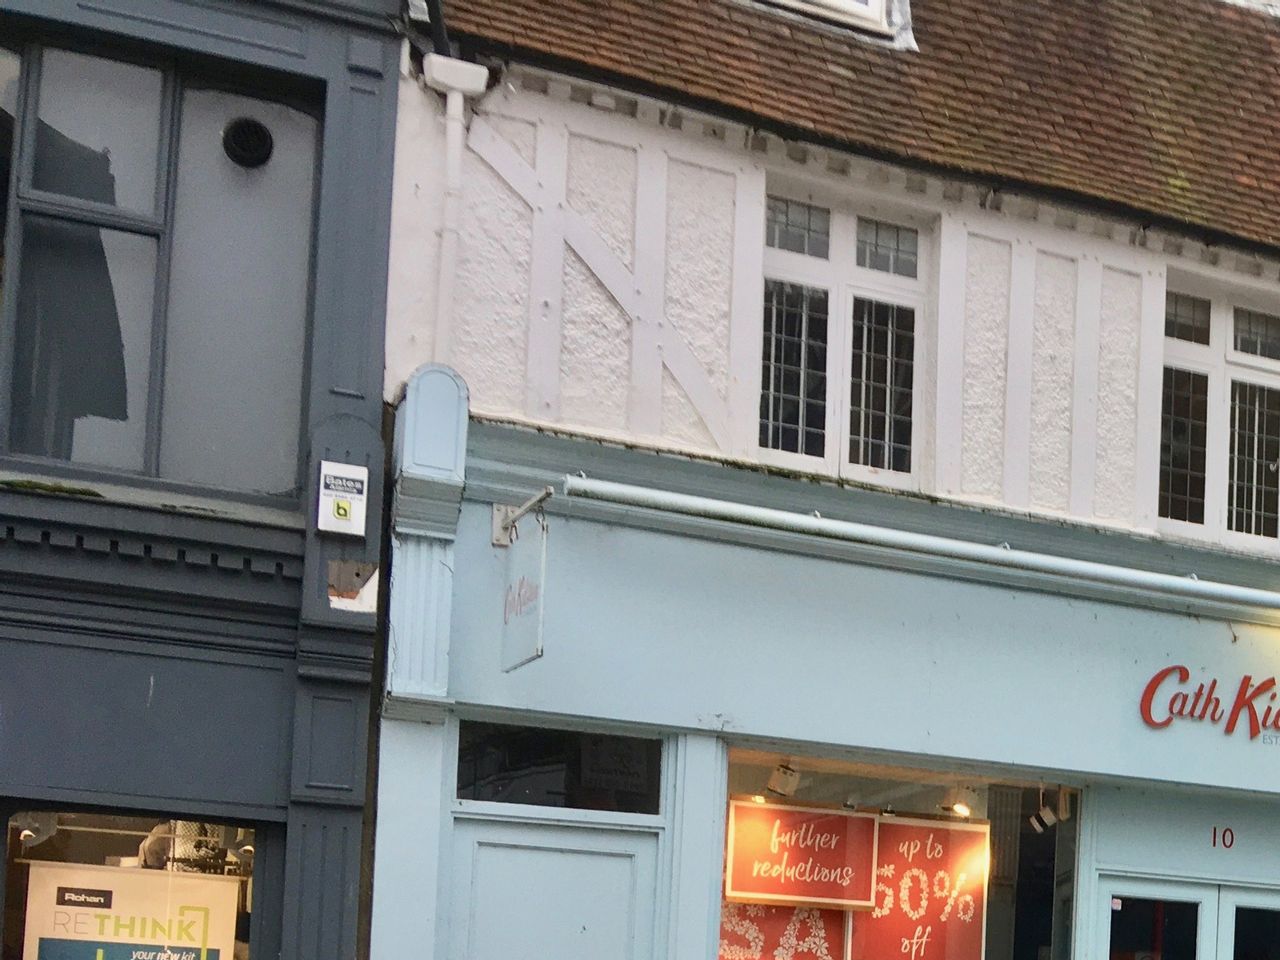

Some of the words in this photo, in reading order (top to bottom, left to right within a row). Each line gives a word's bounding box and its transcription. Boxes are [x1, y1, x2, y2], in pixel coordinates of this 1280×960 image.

[1139, 664, 1225, 730] Cath
[770, 819, 840, 854] further
[899, 839, 921, 862] up
[925, 833, 944, 859] to
[1212, 826, 1235, 849] 10
[752, 851, 855, 887] reductions
[64, 892, 105, 904] Rohan
[872, 864, 975, 923] 50%
[53, 911, 197, 942] RETHINK
[901, 925, 932, 960] off
